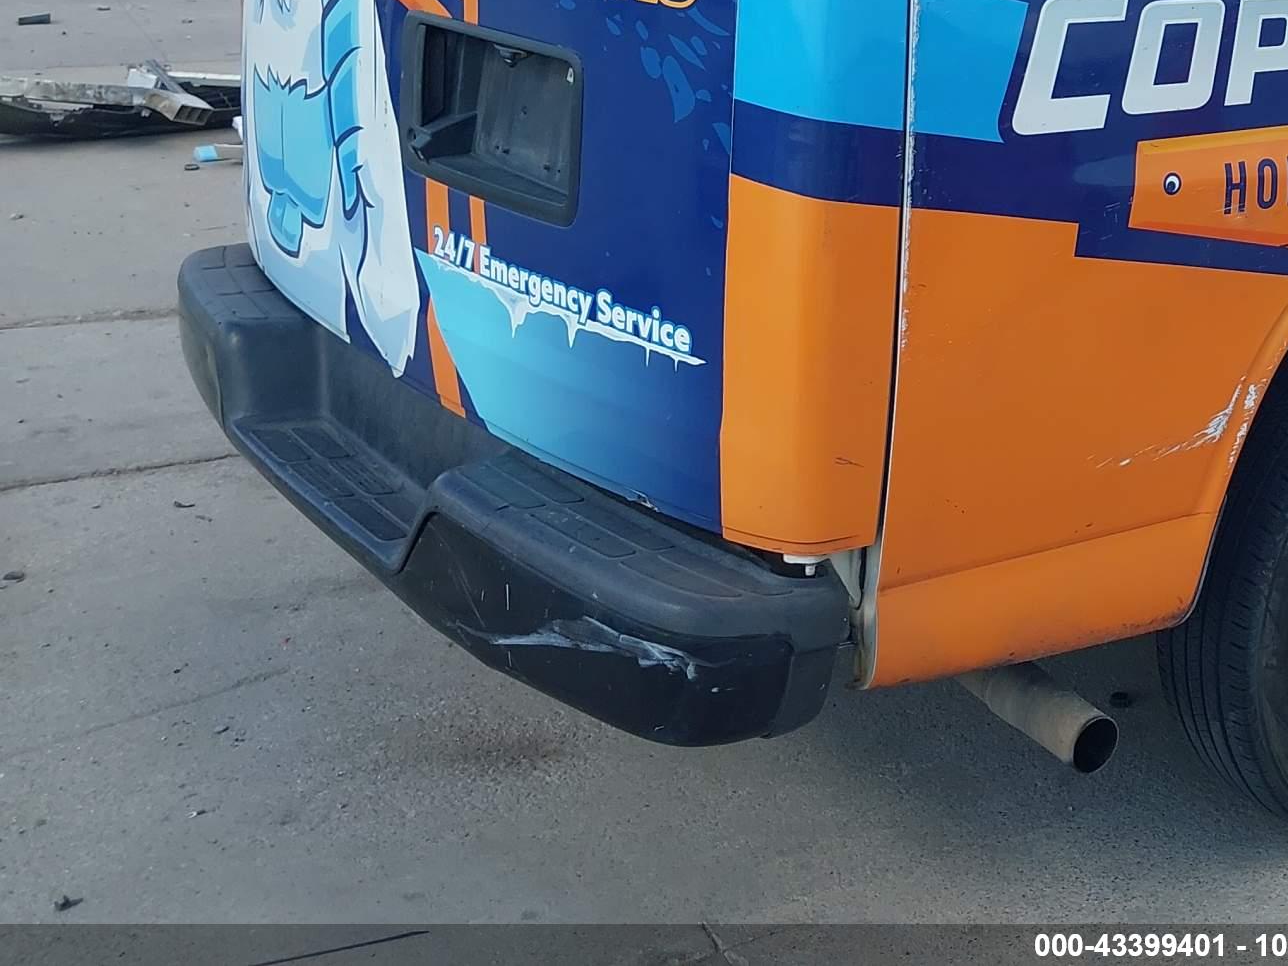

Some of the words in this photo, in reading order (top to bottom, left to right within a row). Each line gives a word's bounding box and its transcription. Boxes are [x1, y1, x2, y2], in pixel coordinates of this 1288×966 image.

[433, 226, 476, 271] 24/7
[478, 245, 594, 324] Emergency
[596, 290, 692, 352] Service
